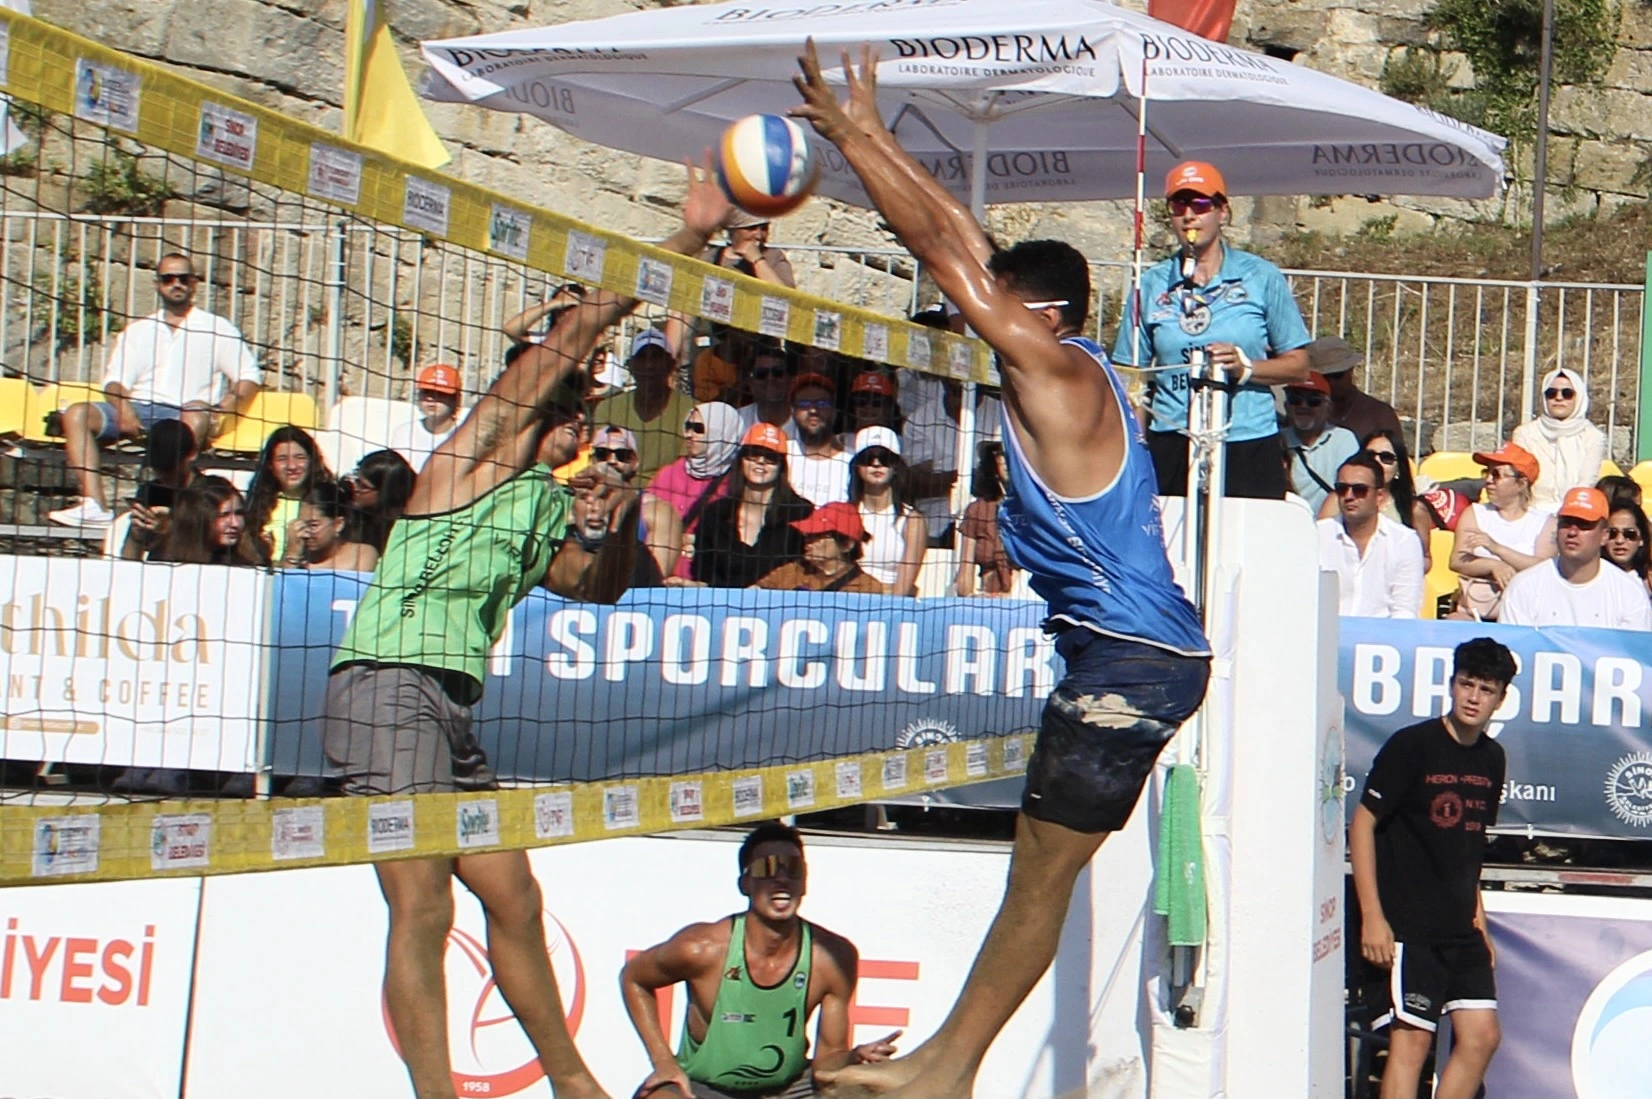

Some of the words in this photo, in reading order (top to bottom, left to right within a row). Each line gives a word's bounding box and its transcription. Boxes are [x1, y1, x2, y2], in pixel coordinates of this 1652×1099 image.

[890, 34, 1096, 63] BIODERMA
[1139, 32, 1279, 73] BIODERMA
[899, 64, 978, 77] LABORATOIRE
[984, 65, 1096, 78] DERMATOLOGIQUE
[1145, 66, 1214, 78] LABORATOIRE
[63, 677, 77, 702] &
[99, 679, 209, 709] COFFEE
[0, 917, 156, 1006] İYESİ
[783, 1007, 797, 1037] 1
[463, 1081, 491, 1093] 1958
